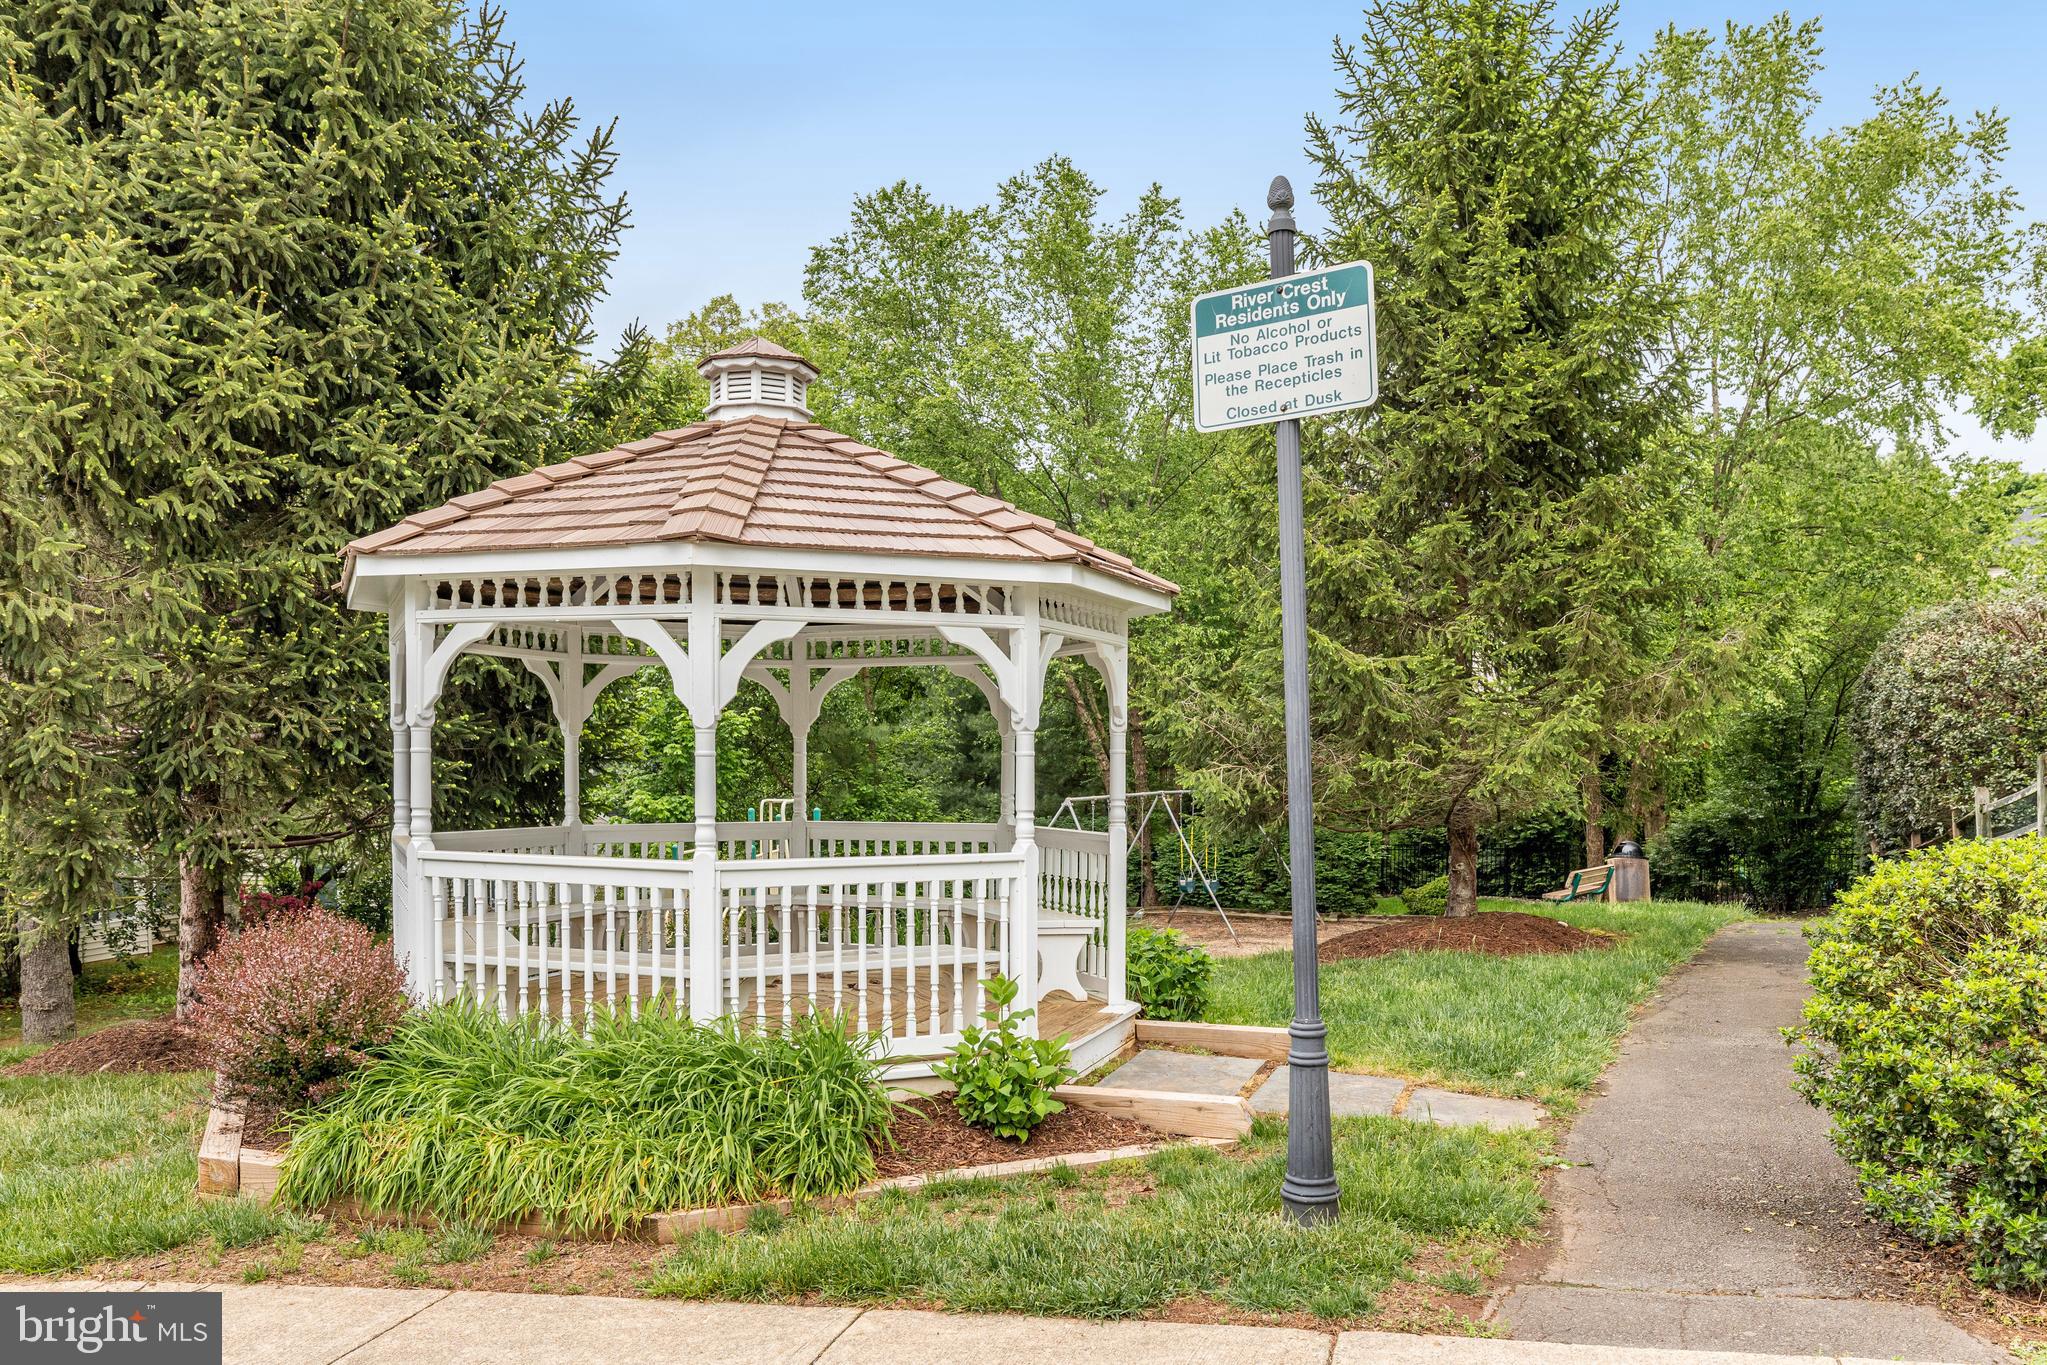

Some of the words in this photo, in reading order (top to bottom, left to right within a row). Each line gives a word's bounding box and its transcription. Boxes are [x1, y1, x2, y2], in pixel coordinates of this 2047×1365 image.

[1215, 302, 1299, 329] Residents
[1306, 290, 1347, 310] Only
[1231, 290, 1274, 310] River
[1281, 277, 1328, 299] Crest
[1203, 352, 1221, 365] Lit
[1227, 340, 1288, 360] Tobacco
[1295, 325, 1362, 347] Products
[1230, 333, 1249, 346] No
[1256, 319, 1310, 341] Alcohol
[1317, 316, 1333, 329] or
[1204, 367, 1251, 386] Please
[1258, 361, 1298, 377] Place
[1304, 350, 1343, 368] Trash
[1350, 348, 1363, 360] in
[1225, 384, 1248, 397] the
[1255, 367, 1342, 392] Recepticles
[1226, 400, 1277, 420] Closed
[1284, 398, 1298, 410] at
[1305, 389, 1343, 407] Dusk
